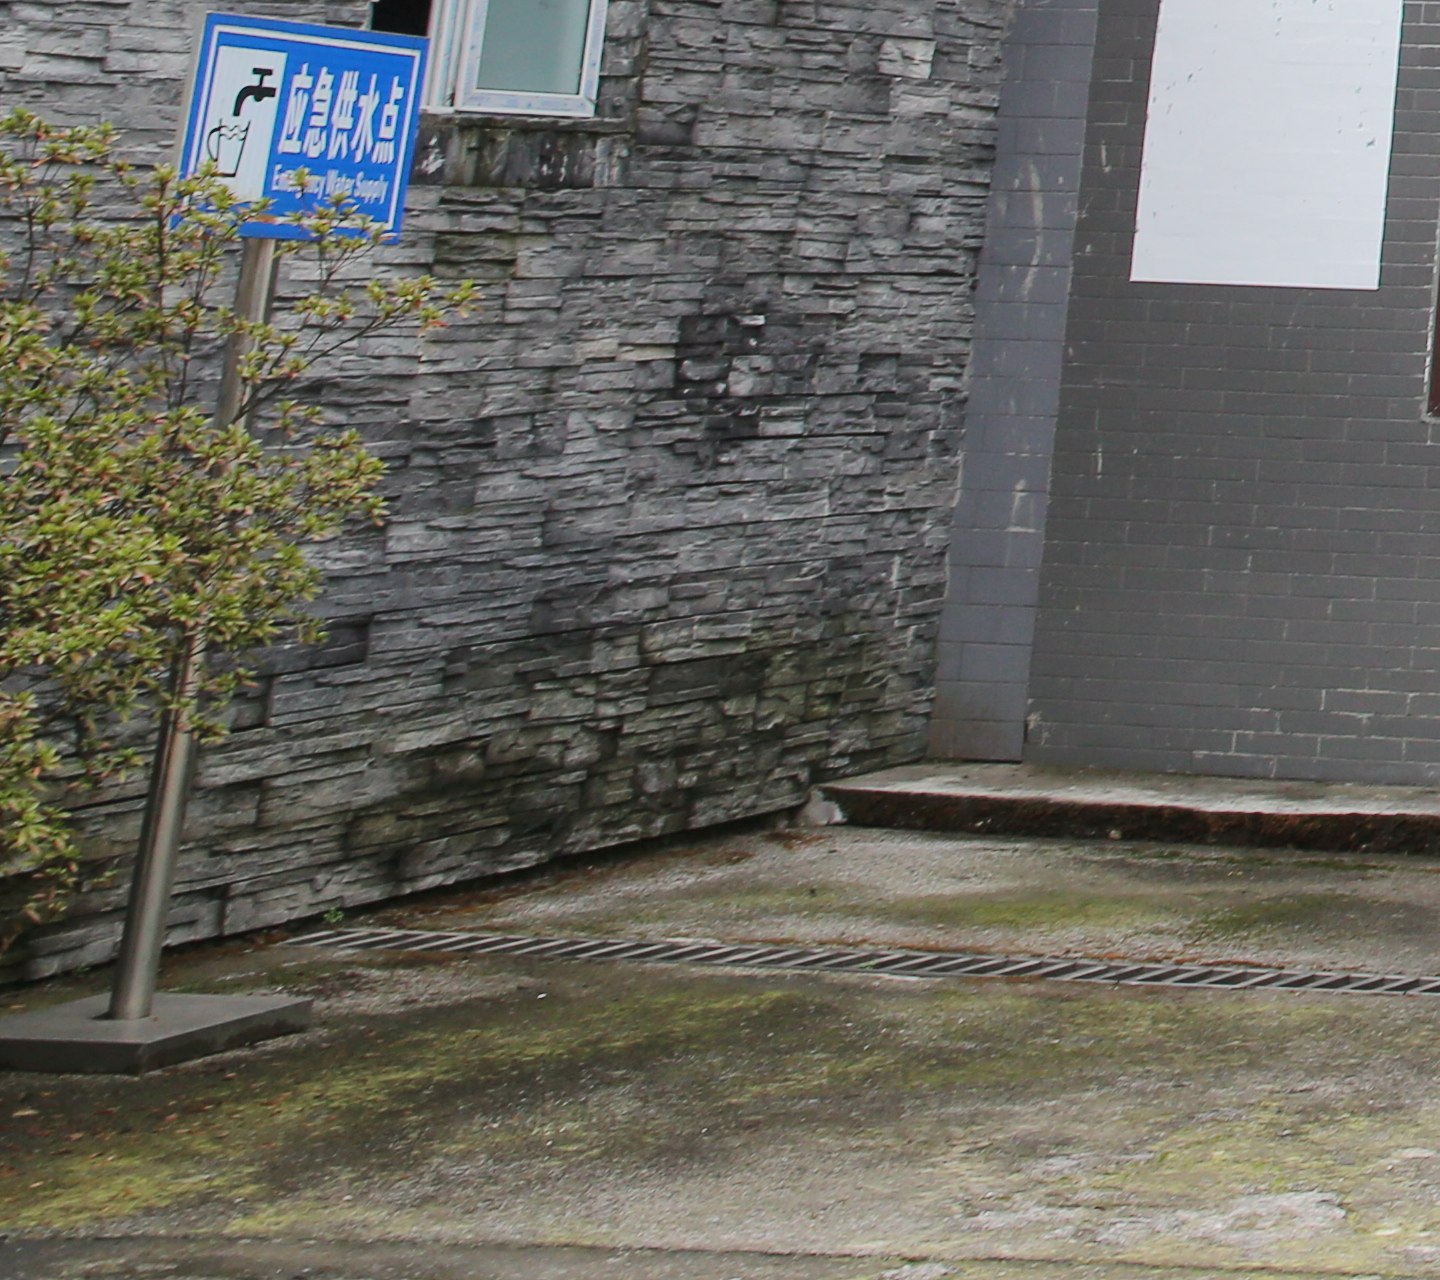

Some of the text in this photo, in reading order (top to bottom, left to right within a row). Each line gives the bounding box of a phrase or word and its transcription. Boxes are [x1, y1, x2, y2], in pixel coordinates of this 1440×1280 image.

[277, 61, 406, 166] 应急供水点
[354, 170, 389, 205] Supply
